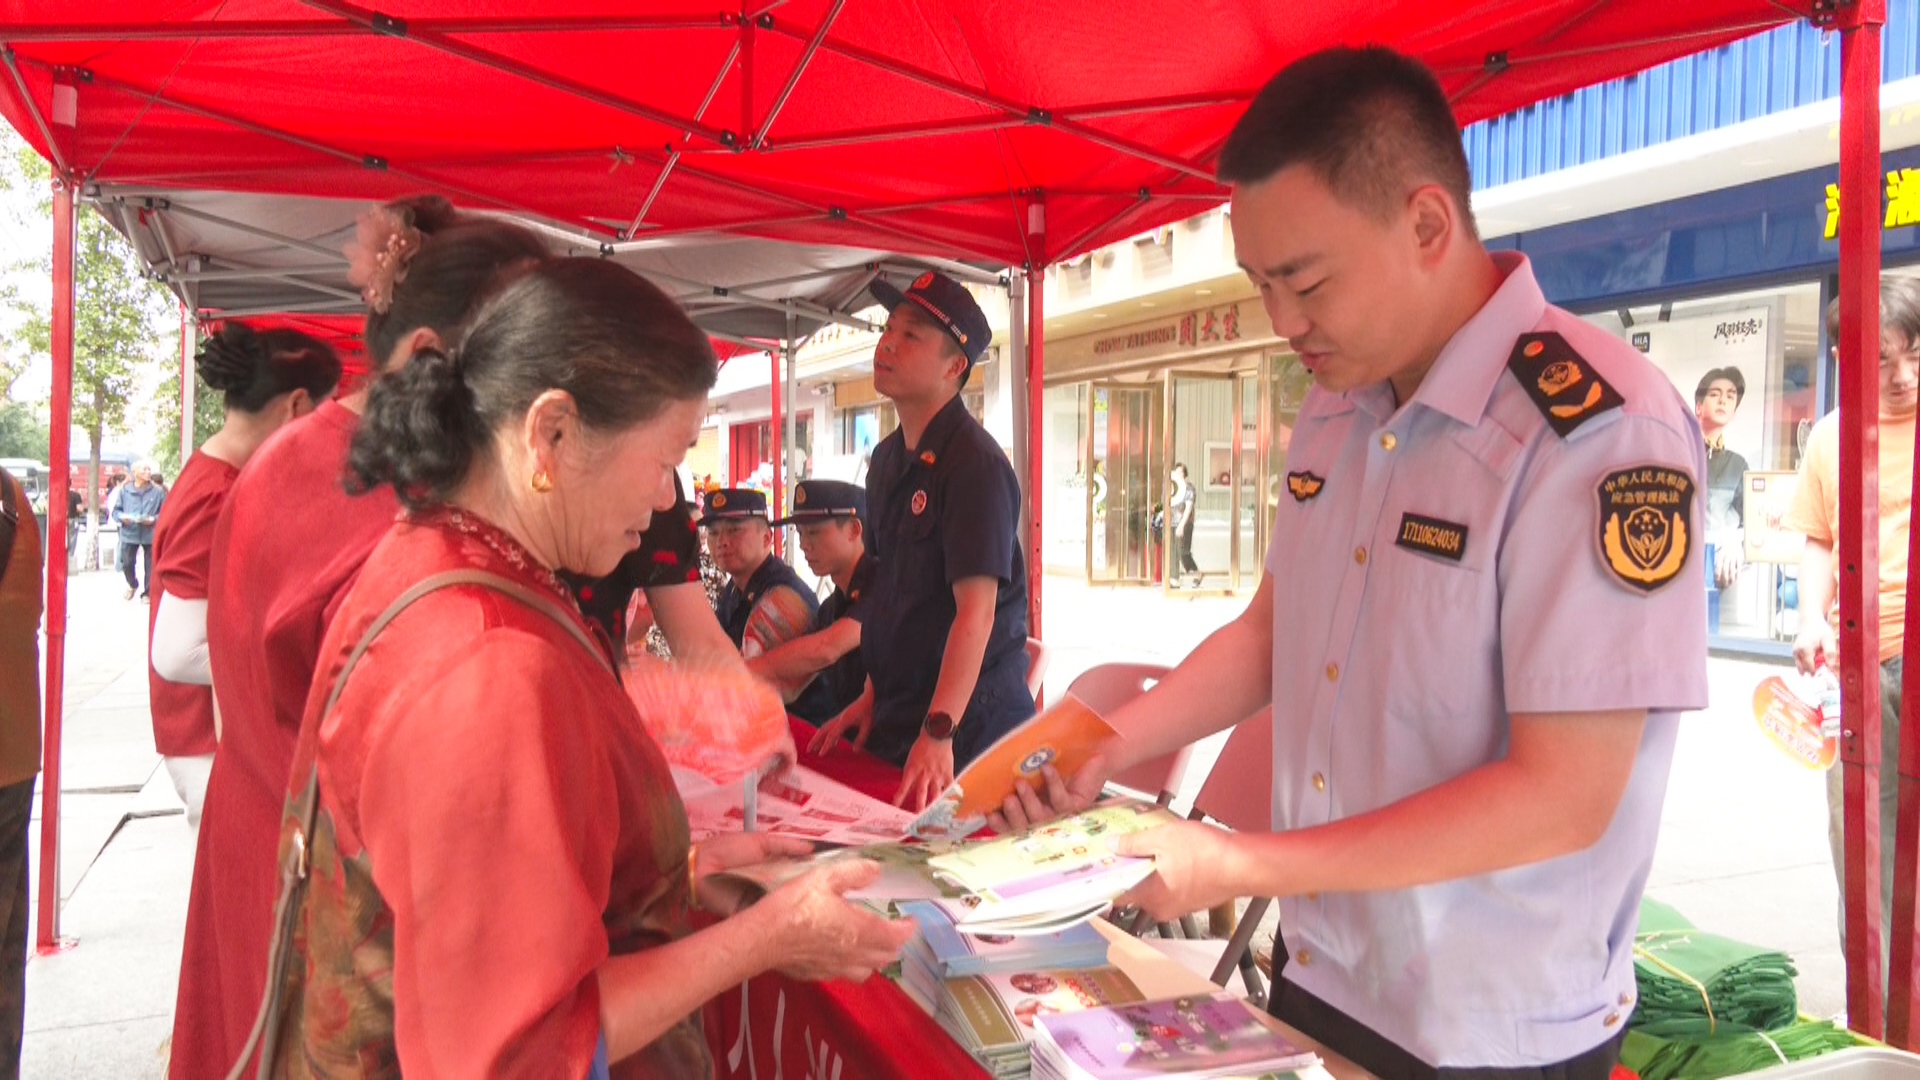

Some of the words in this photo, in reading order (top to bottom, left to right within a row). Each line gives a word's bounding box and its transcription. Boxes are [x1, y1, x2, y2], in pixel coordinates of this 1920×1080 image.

[1605, 470, 1688, 492] 中华人民共和国
[1611, 491, 1679, 504] 应急管理执法
